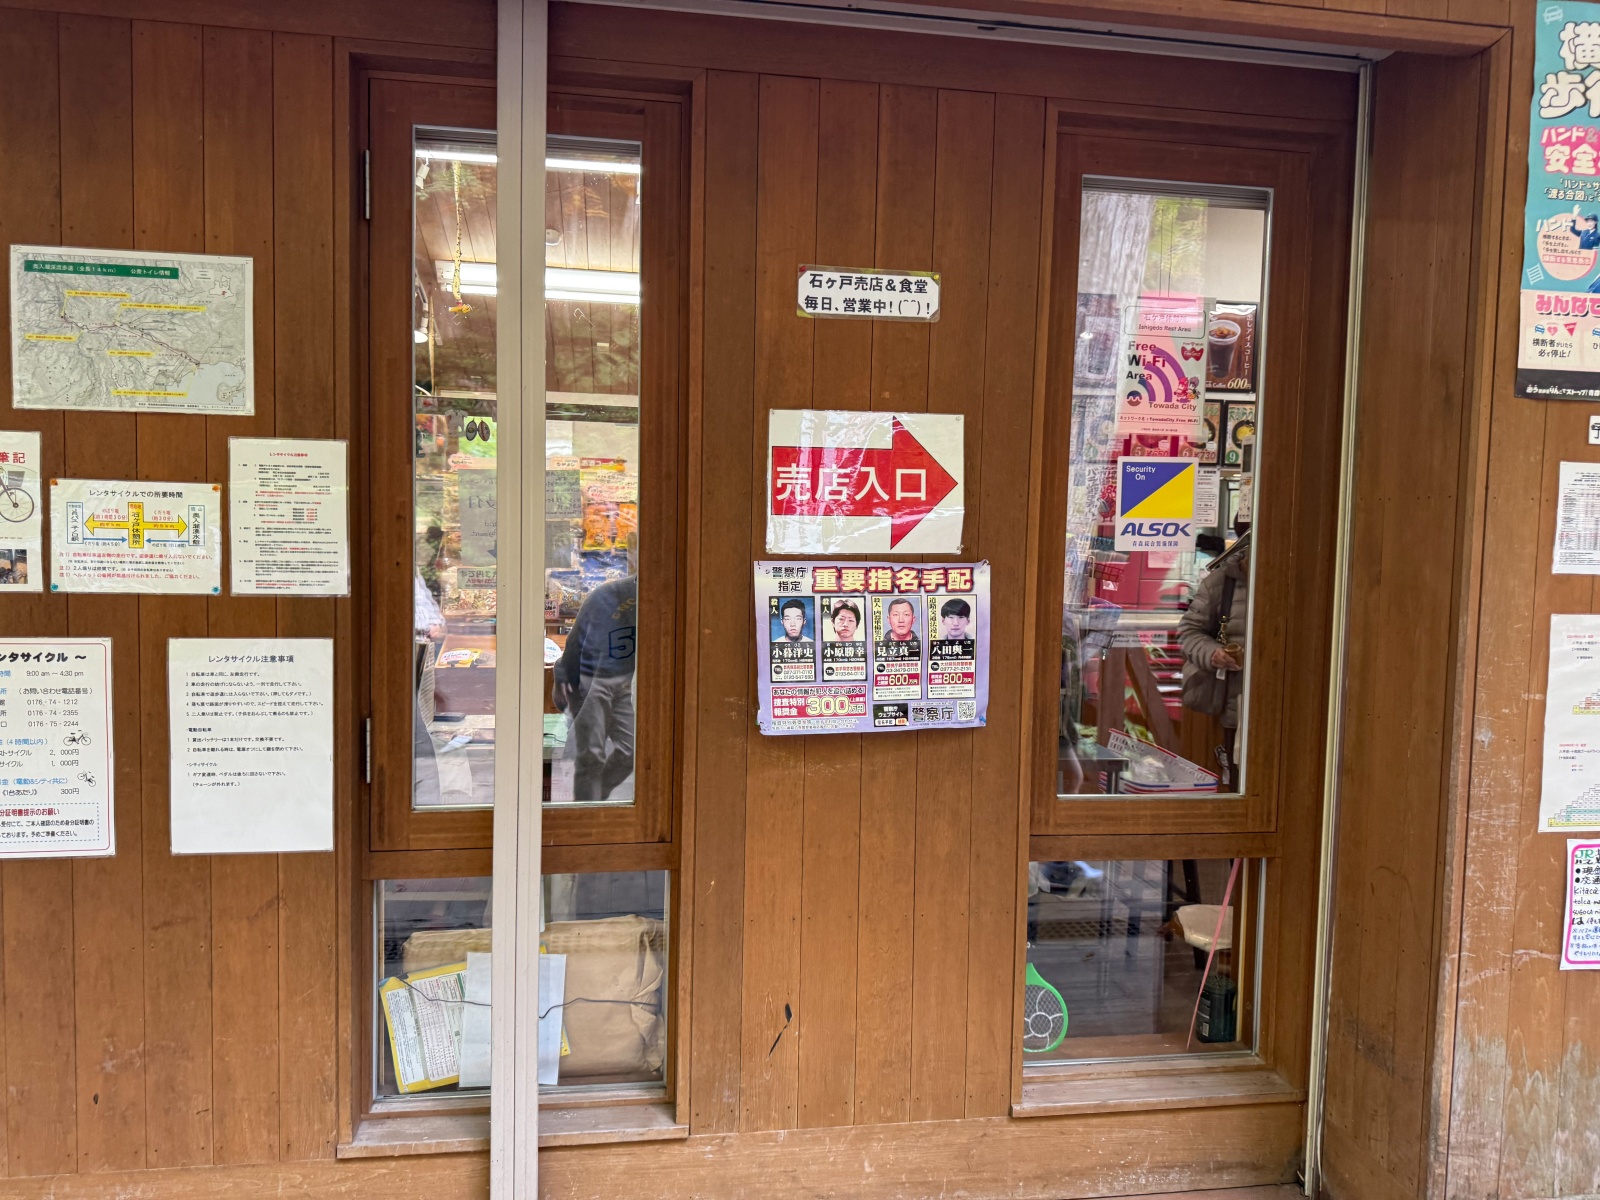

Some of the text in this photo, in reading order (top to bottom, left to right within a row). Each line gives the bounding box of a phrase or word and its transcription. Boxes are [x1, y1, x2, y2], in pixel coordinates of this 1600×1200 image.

[1544, 143, 1600, 175] 安全
[809, 273, 928, 294] 石ヶ戸売店&食堂
[1127, 340, 1157, 351] Free
[1127, 354, 1166, 368] Wi-Fi
[1126, 370, 1153, 380] Area
[1148, 402, 1197, 412] Towada City
[1229, 452, 1236, 462] 9
[1126, 466, 1156, 474] Security
[776, 463, 927, 501] 売店入口
[89, 489, 184, 499] レンタサイクルでの所要時間
[1120, 522, 1192, 537] ALSOK
[772, 566, 974, 593] 警察庁 重要指名手配
[778, 581, 802, 593] 指定
[208, 655, 295, 663] レンタサイクル注意事項
[912, 706, 954, 722] 警察庁
[0, 820, 95, 828] 受付にて、ご本人確認のため身分証明書の
